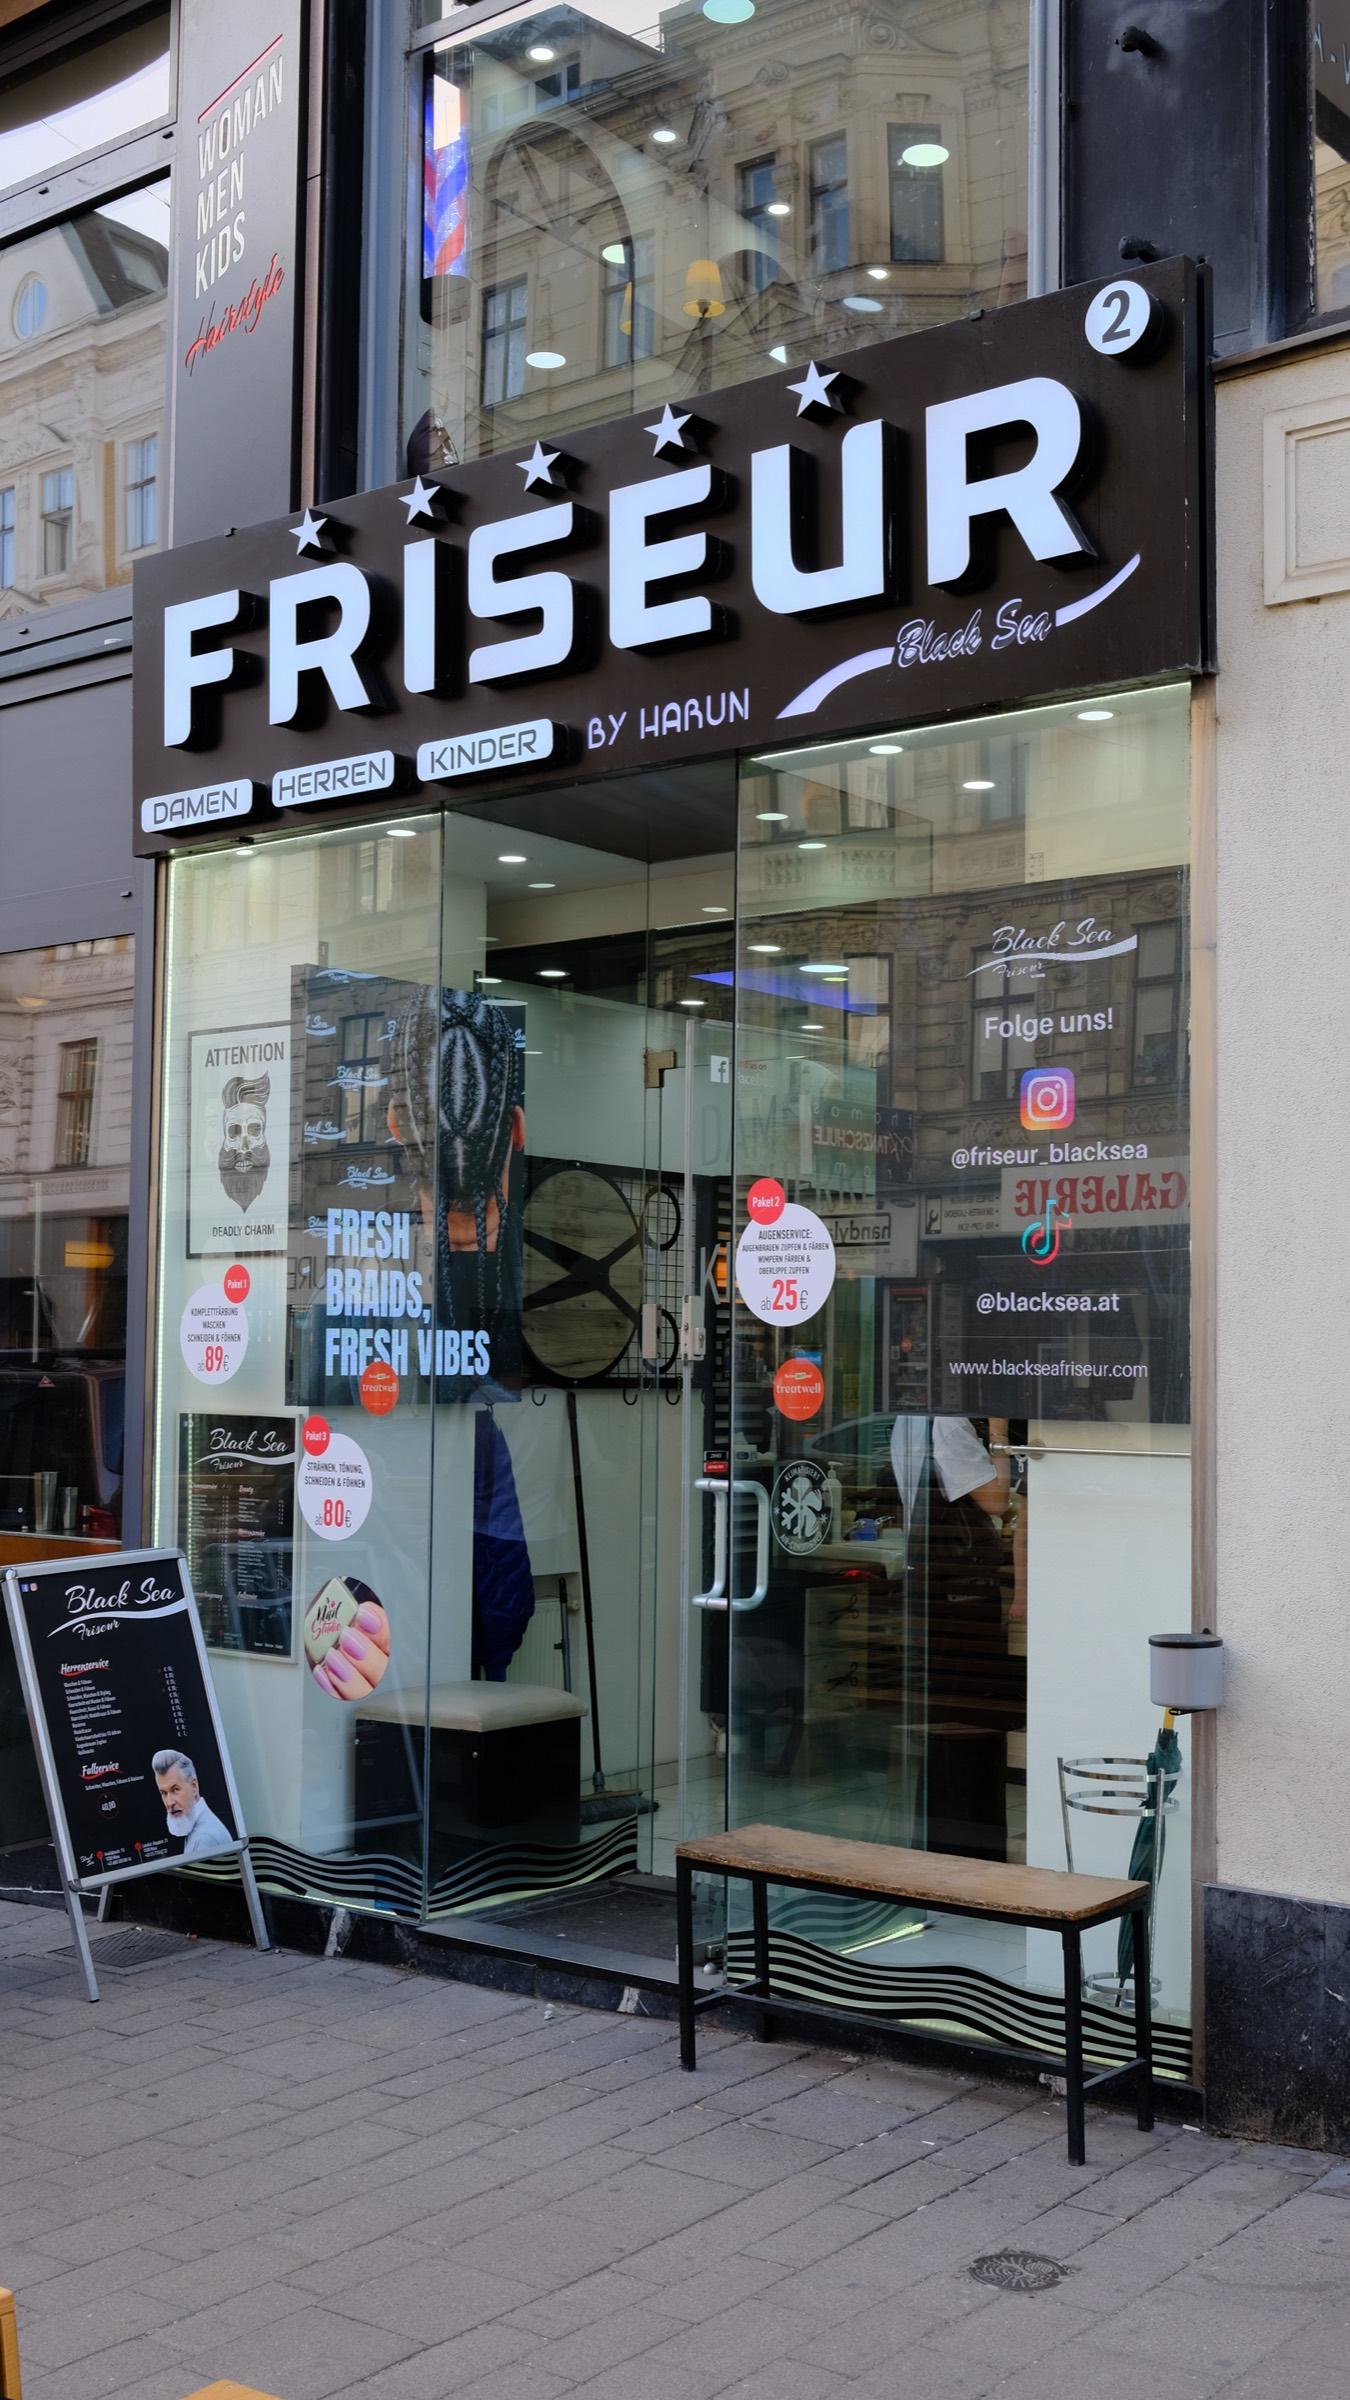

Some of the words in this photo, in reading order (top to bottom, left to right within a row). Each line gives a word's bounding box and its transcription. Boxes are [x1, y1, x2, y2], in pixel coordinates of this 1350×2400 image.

[197, 55, 284, 180] WOMAN
[196, 152, 245, 240] MEN
[195, 210, 246, 299] KIDS
[184, 253, 286, 376] Hairstyle
[1101, 289, 1132, 344] 2
[163, 377, 1087, 748] FRISEUR
[897, 609, 983, 668] Black
[991, 598, 1053, 650] Sea
[587, 712, 628, 750] BY
[640, 688, 749, 741] HARUN
[429, 728, 538, 774] KINDER
[278, 757, 387, 802] HERREN
[153, 788, 239, 826] DAMEN
[991, 921, 1066, 954] Black
[1067, 917, 1115, 946] Sea
[991, 961, 1044, 981] Friseur
[985, 1013, 1054, 1042] Folge
[1060, 1007, 1113, 1033] uns!
[205, 1041, 285, 1068] ATTENTION
[951, 1141, 1149, 1169] @friseur_blacksea
[752, 1197, 773, 1208] Paket
[774, 1196, 780, 1207] 2
[212, 1225, 243, 1238] DEADLY
[244, 1223, 275, 1236] CHARM
[327, 1207, 410, 1260] FRESH
[758, 1229, 813, 1241] AUGENSERVICE:
[742, 1243, 779, 1253] AUGENBRAUEN
[781, 1242, 802, 1252] ZUPFEN
[803, 1242, 808, 1251] &
[809, 1241, 830, 1251] FÄRBEN
[806, 1254, 812, 1263] &
[227, 1279, 244, 1289] Paket
[326, 1267, 431, 1324] BRAIDS,
[190, 1306, 239, 1317] KOMPLETTFÄRBUNG
[976, 1291, 1121, 1314] @blacksea.at
[202, 1320, 226, 1330] WASCHEN
[187, 1333, 214, 1343] SCHNEIDEN
[215, 1333, 220, 1342] &
[221, 1331, 241, 1342] FÖHNEN
[325, 1328, 409, 1377] FRESH
[417, 1328, 491, 1377] VIBES
[949, 1359, 1149, 1378] www.blackseafriseur.com
[363, 1382, 397, 1393] treatwell
[776, 1382, 821, 1394] treatwell
[209, 1428, 257, 1451] Black
[258, 1430, 289, 1453] Sea
[305, 1430, 321, 1441] Paket
[321, 1430, 327, 1441] 3
[209, 1458, 245, 1472] Friseur
[304, 1475, 336, 1487] SCHNEIDEN
[337, 1479, 342, 1487] &
[343, 1478, 366, 1489] FÖHNEN
[65, 1580, 131, 1614] Black
[134, 1577, 176, 1605] Sea
[316, 1601, 342, 1622] Nail
[72, 1619, 121, 1640] Friseur
[60, 1659, 110, 1674] Herrenservice
[82, 1761, 120, 1777] Fullservice
